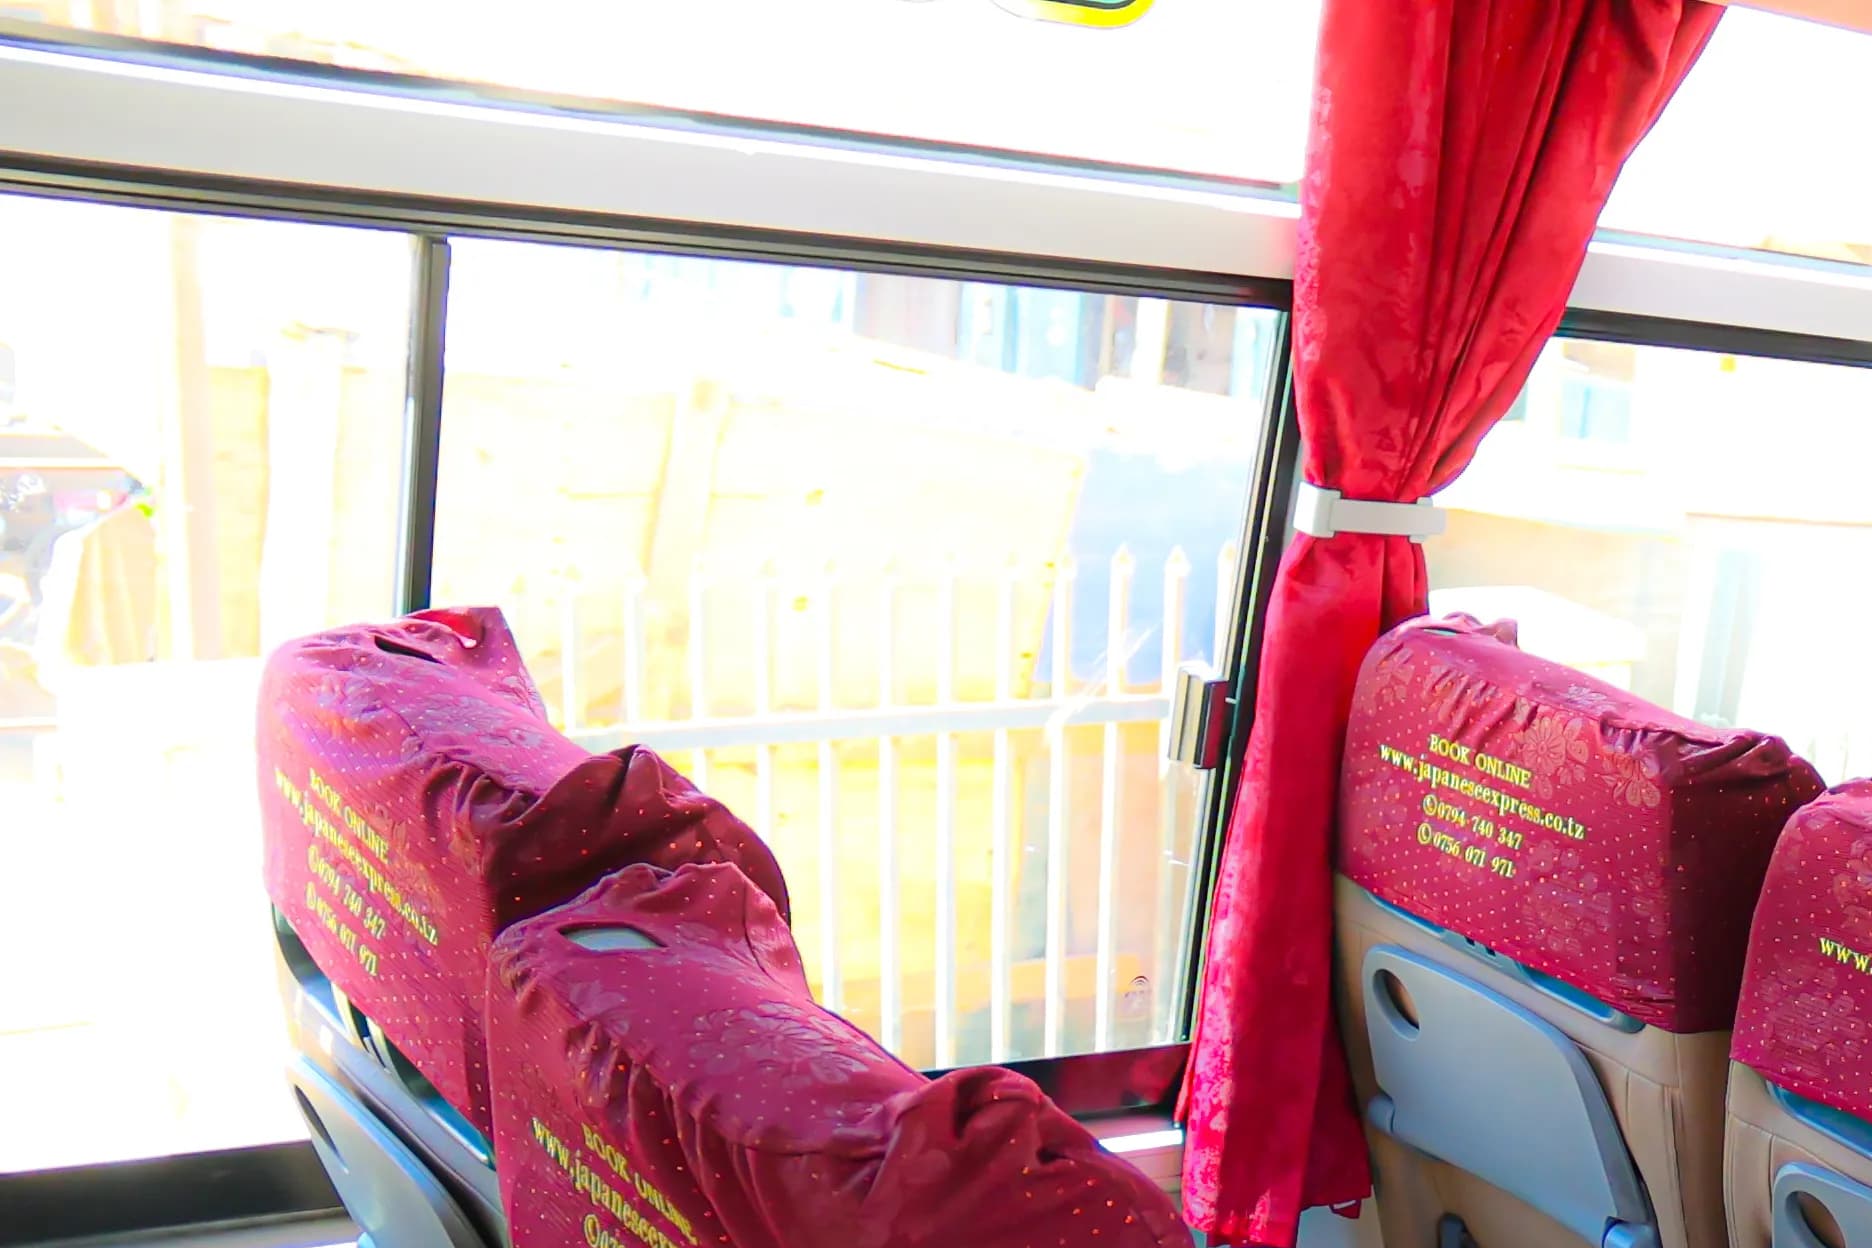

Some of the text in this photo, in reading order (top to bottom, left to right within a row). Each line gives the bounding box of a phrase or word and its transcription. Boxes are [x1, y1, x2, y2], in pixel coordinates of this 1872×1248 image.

[1429, 733, 1532, 789] BOOK ONLINE
[310, 768, 389, 864] BOOK ONLINE
[1380, 744, 1585, 840] www.japaneseexpress.co.tz
[1438, 803, 1523, 850] 0794 740 347
[275, 767, 438, 946] www.japaneseexpress.co.tz
[1433, 833, 1514, 878] 0756 071 971
[344, 884, 362, 917] 740
[364, 907, 386, 940] 347
[359, 944, 378, 976] 971
[581, 1123, 631, 1183] BOOK
